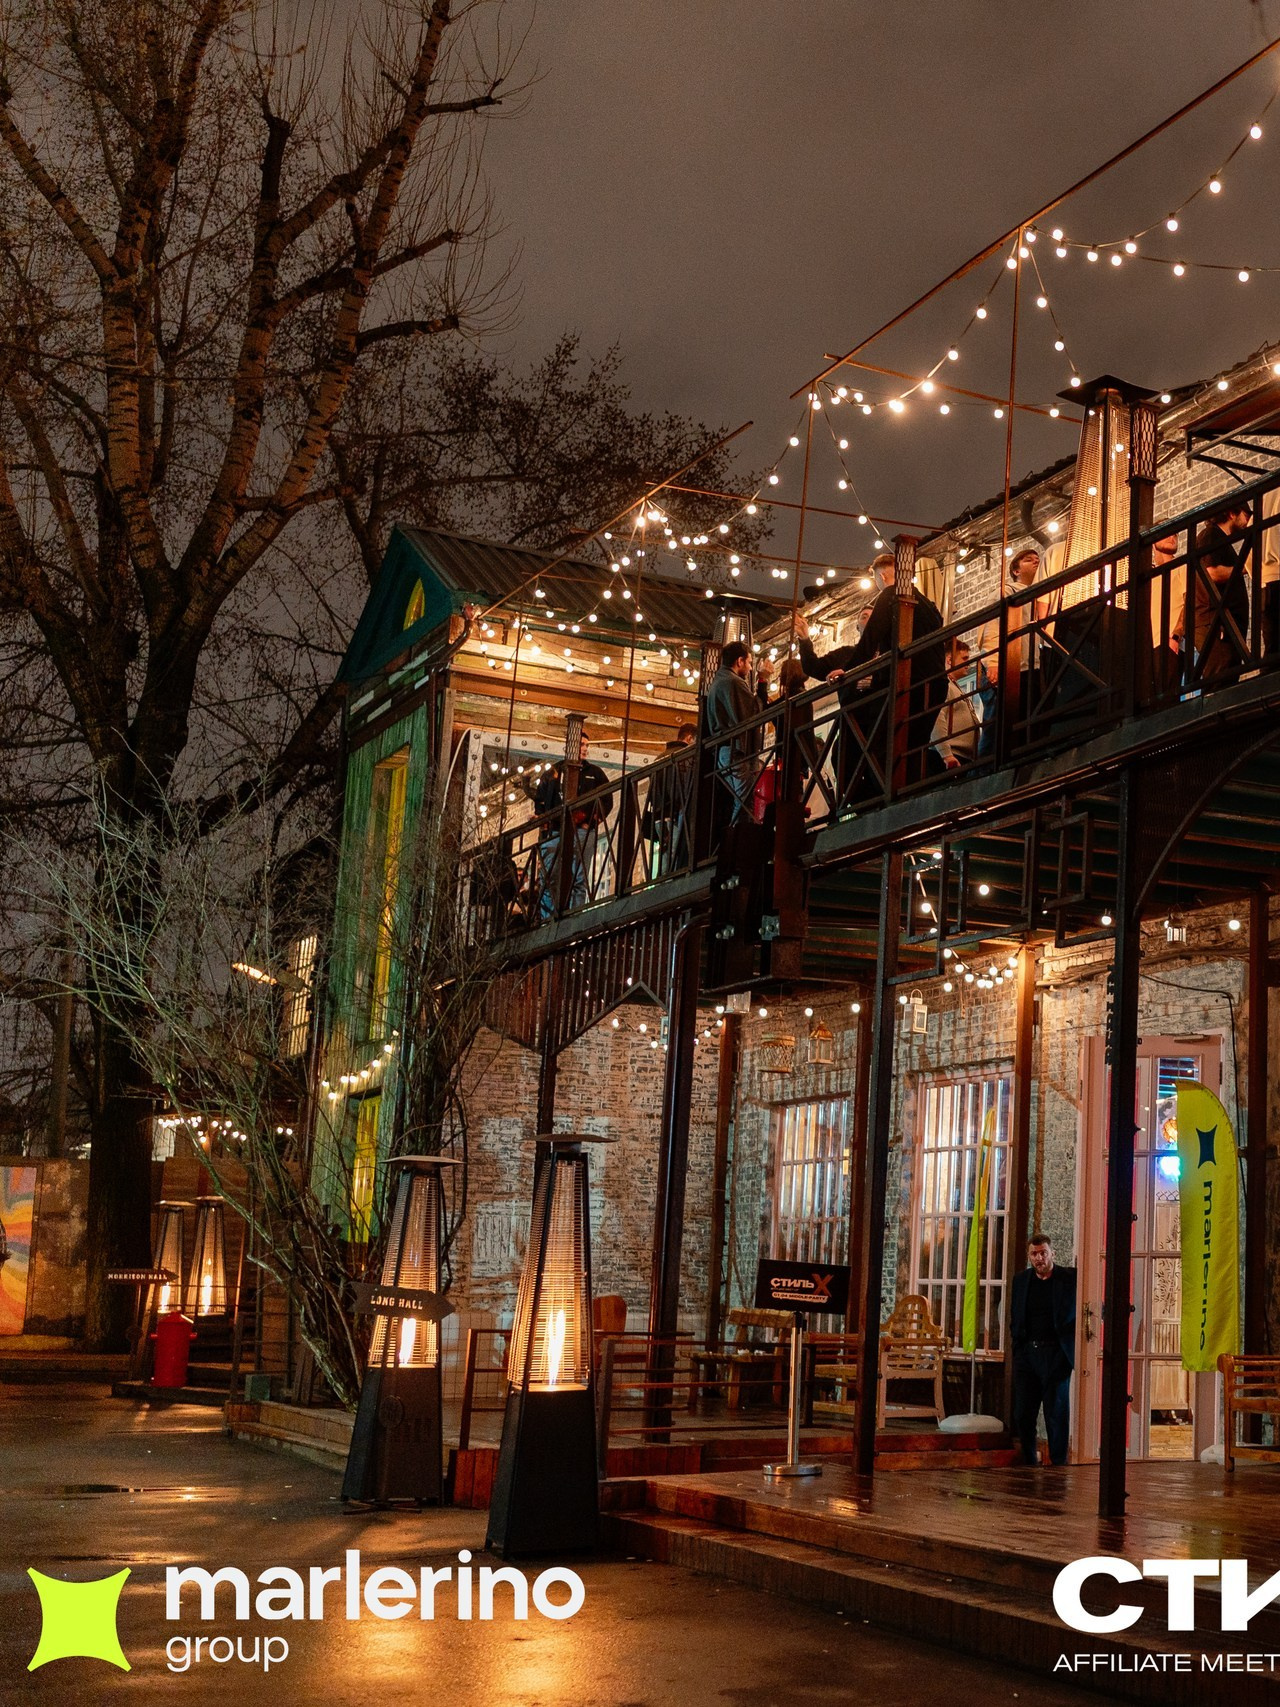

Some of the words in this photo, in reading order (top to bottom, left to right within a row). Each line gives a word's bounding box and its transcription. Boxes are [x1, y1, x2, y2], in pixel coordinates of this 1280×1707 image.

[370, 1295, 395, 1307] LONG
[398, 1298, 423, 1310] HALL
[1200, 1181, 1213, 1352] marlerino
